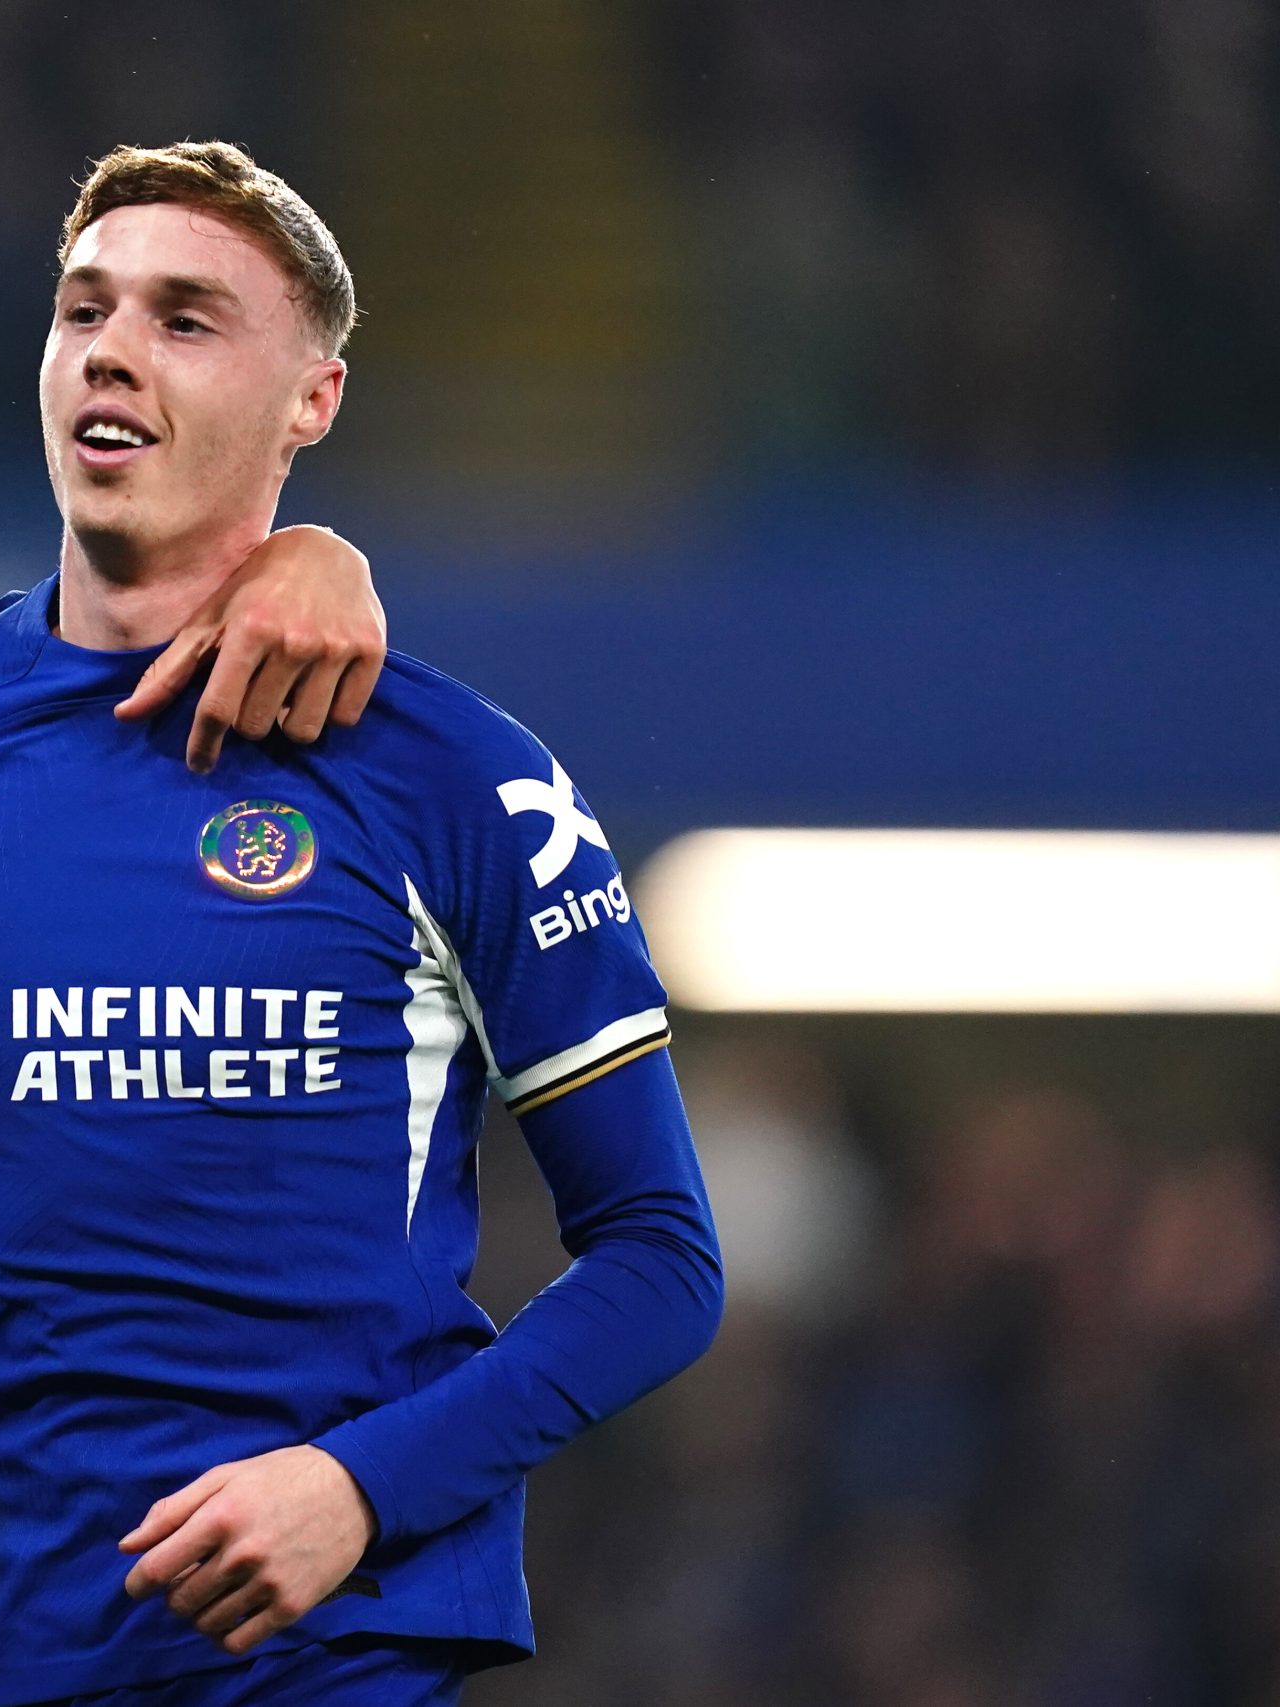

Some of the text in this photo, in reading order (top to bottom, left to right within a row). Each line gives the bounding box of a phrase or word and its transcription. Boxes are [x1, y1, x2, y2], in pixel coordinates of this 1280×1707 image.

[529, 872, 631, 951] Bing
[12, 986, 343, 1039] INFINITE
[11, 1047, 342, 1101] ATHLETE
